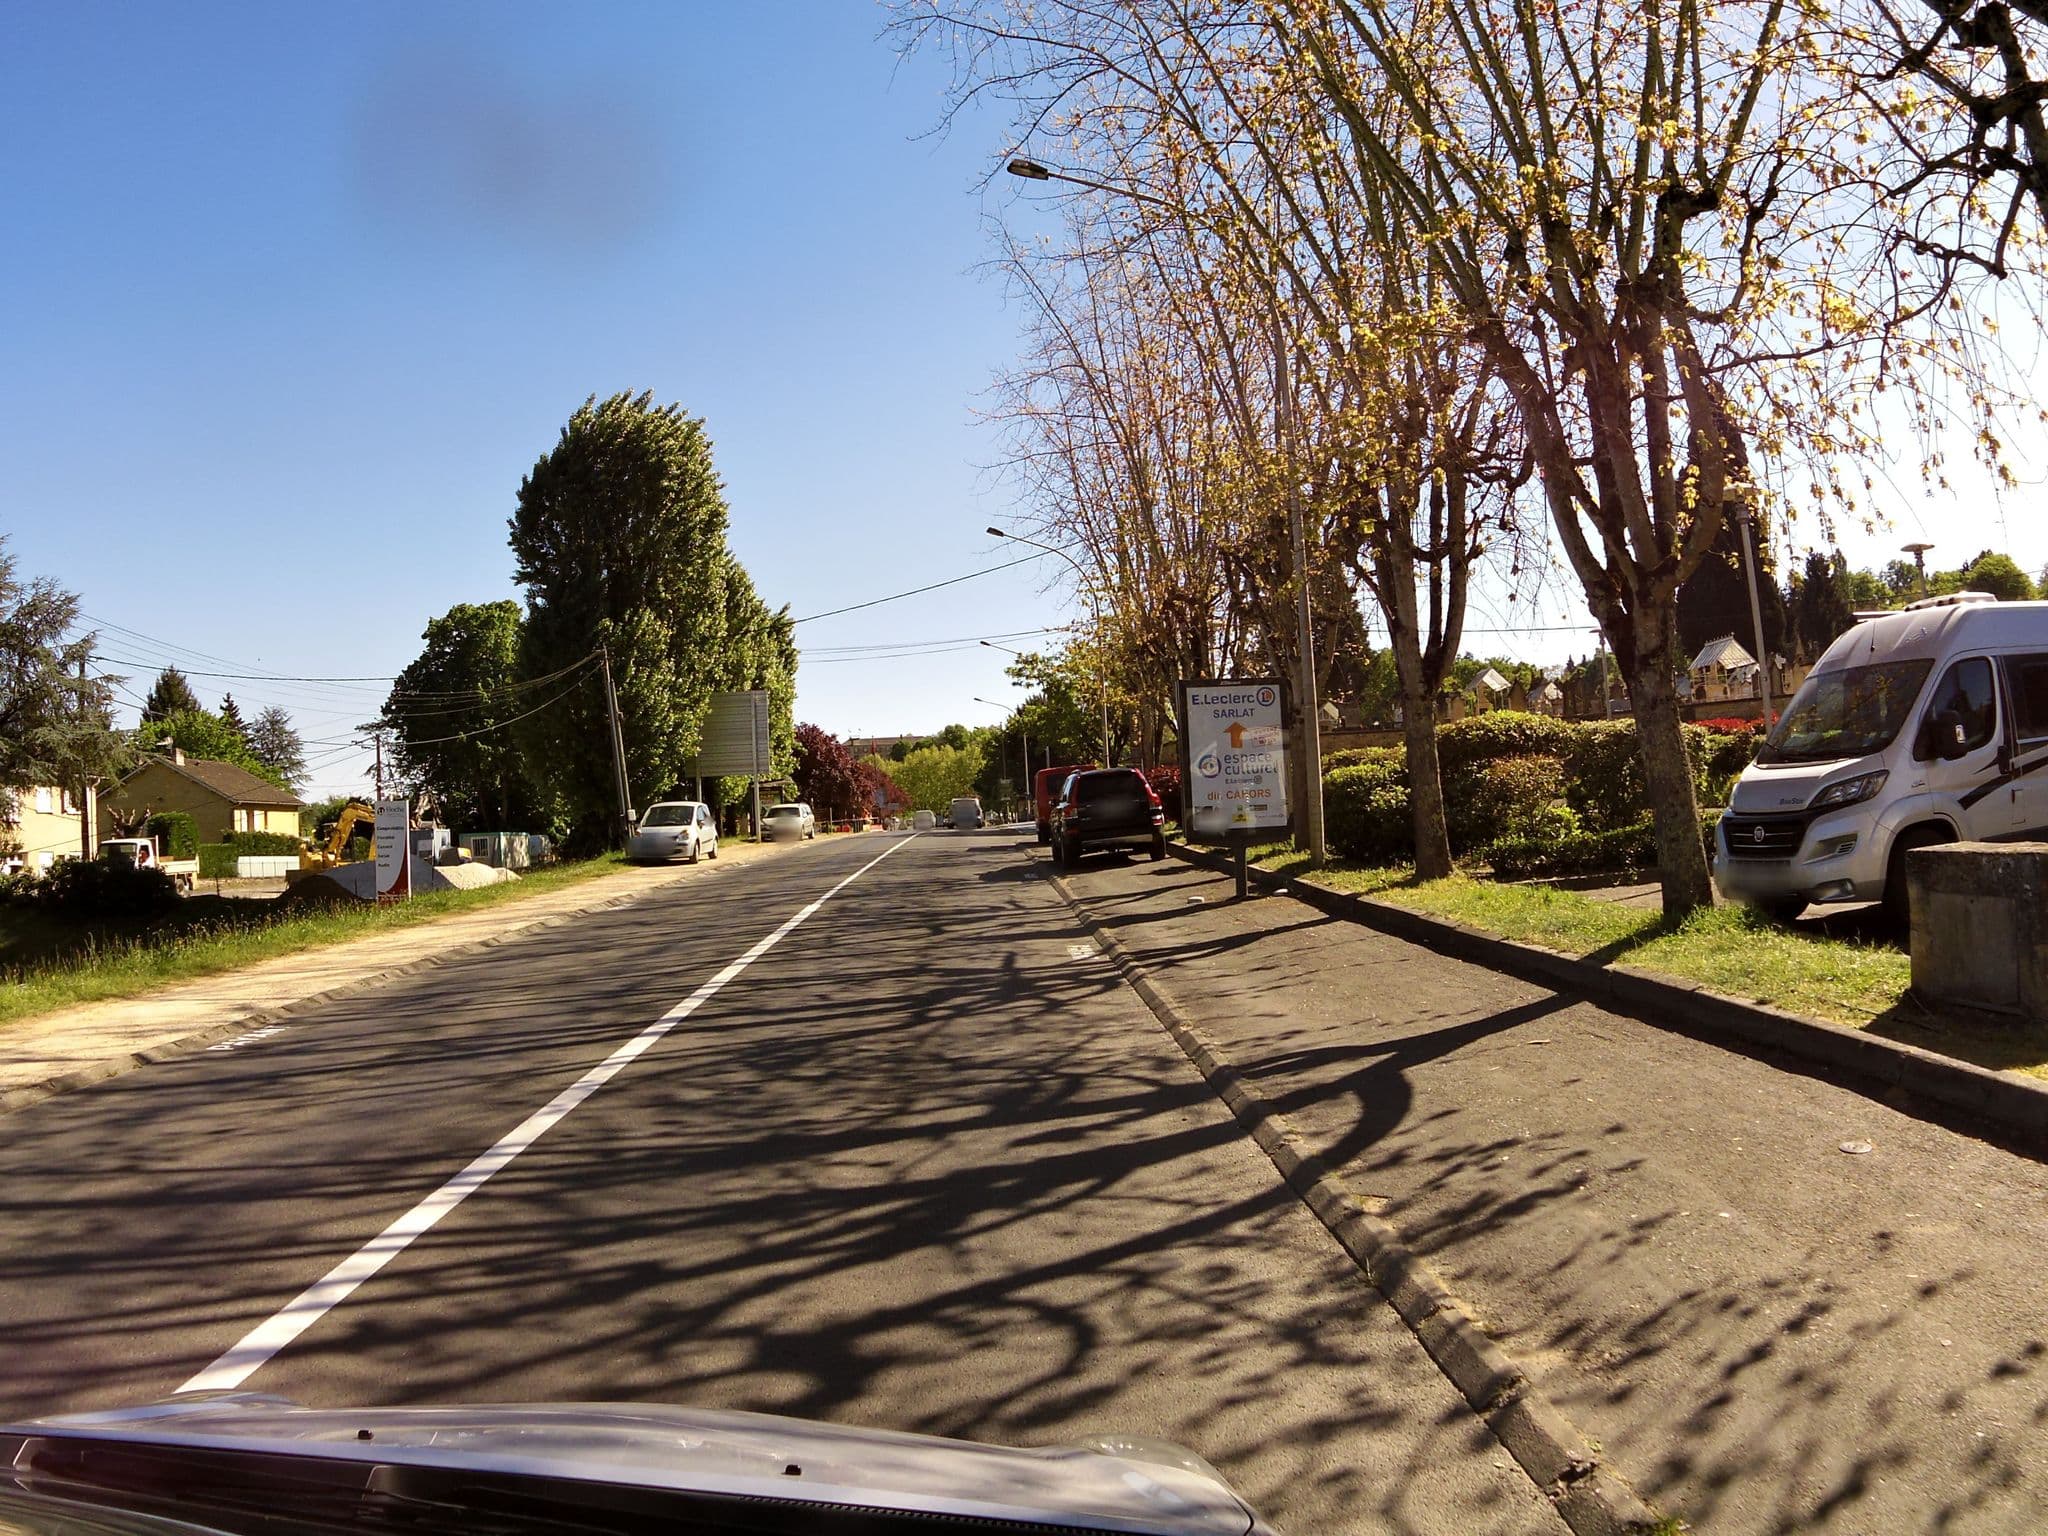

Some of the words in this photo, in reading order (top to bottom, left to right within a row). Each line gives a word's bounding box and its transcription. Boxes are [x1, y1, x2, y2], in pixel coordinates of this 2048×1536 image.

[1191, 693, 1255, 705] E.Leclerc
[1213, 708, 1255, 719] SARLAT
[1224, 753, 1272, 764] espace
[1224, 760, 1279, 776] culturel
[1226, 788, 1271, 800] CAHORS
